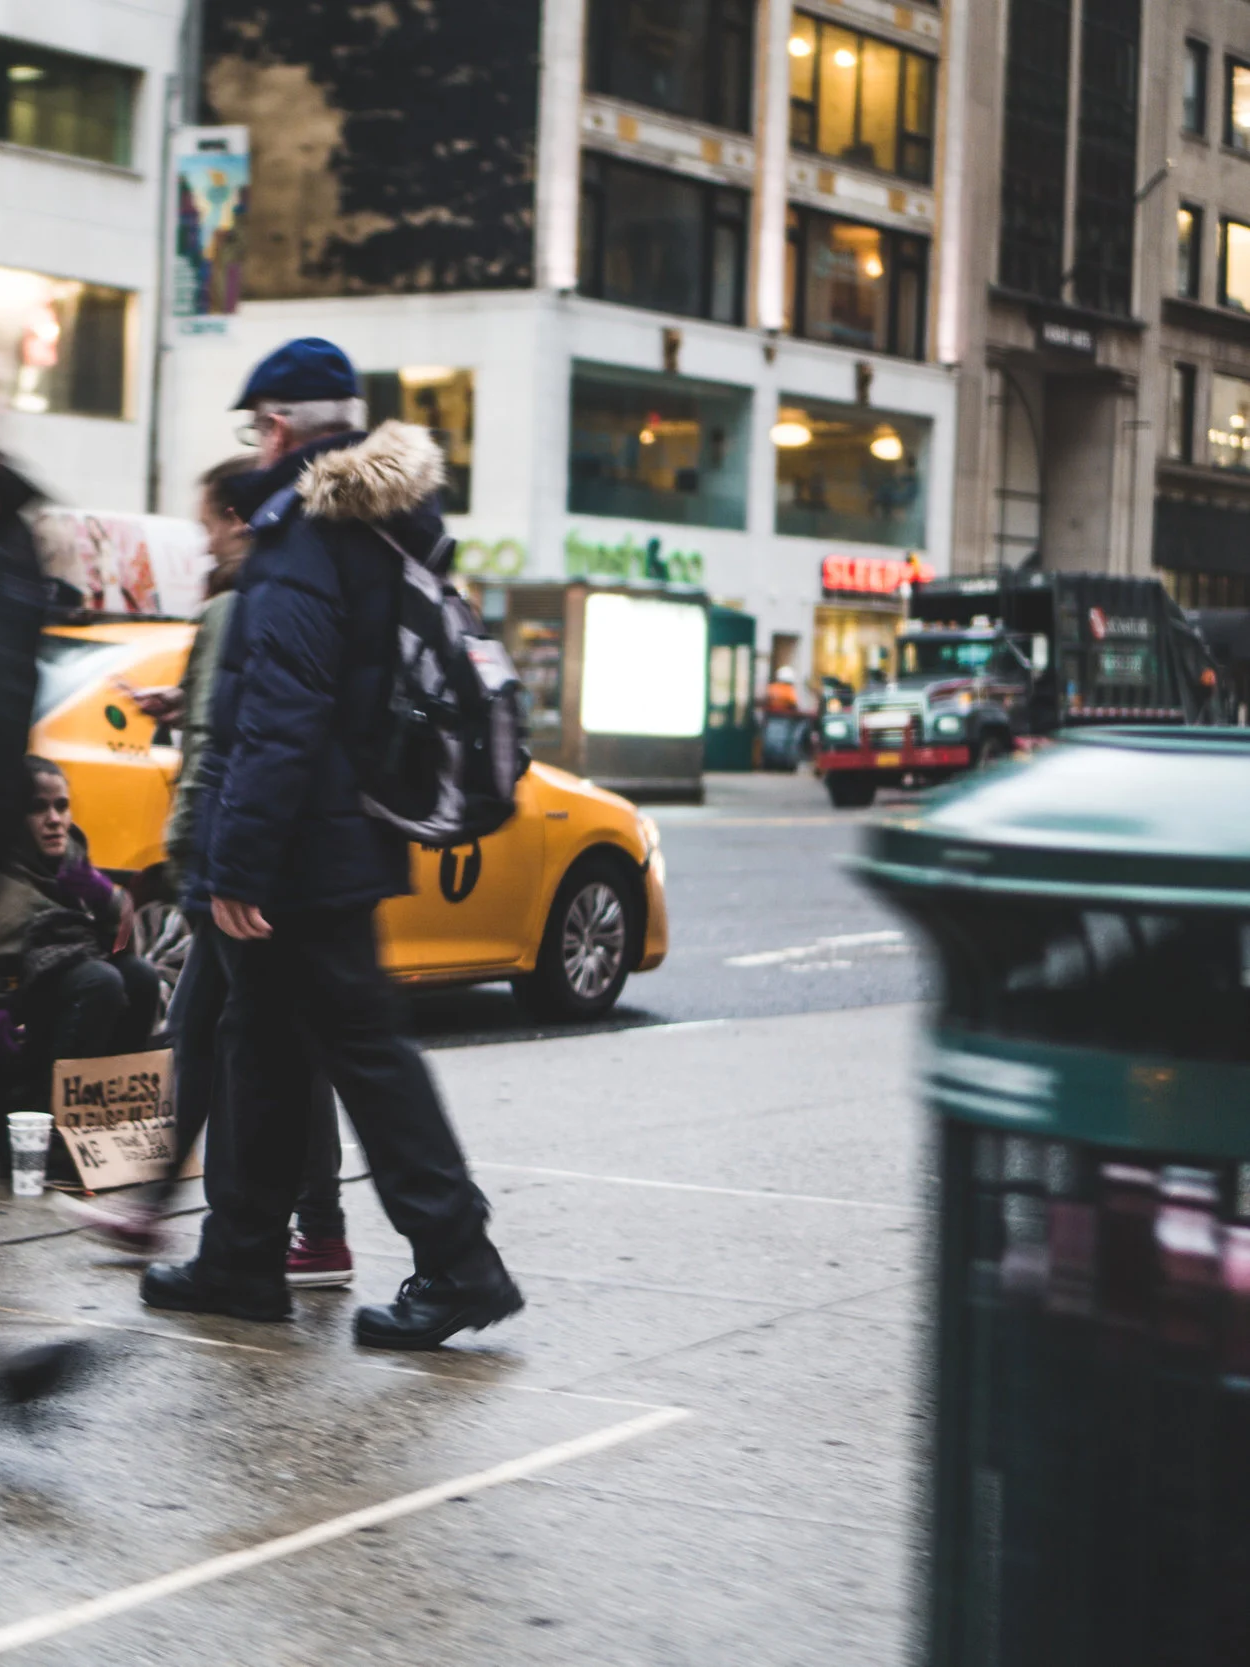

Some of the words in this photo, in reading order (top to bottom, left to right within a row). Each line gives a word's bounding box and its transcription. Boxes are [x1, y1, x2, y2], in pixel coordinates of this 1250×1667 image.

[450, 843, 474, 893] T
[63, 1072, 160, 1107] HOMELESS
[75, 1139, 108, 1168] ME
